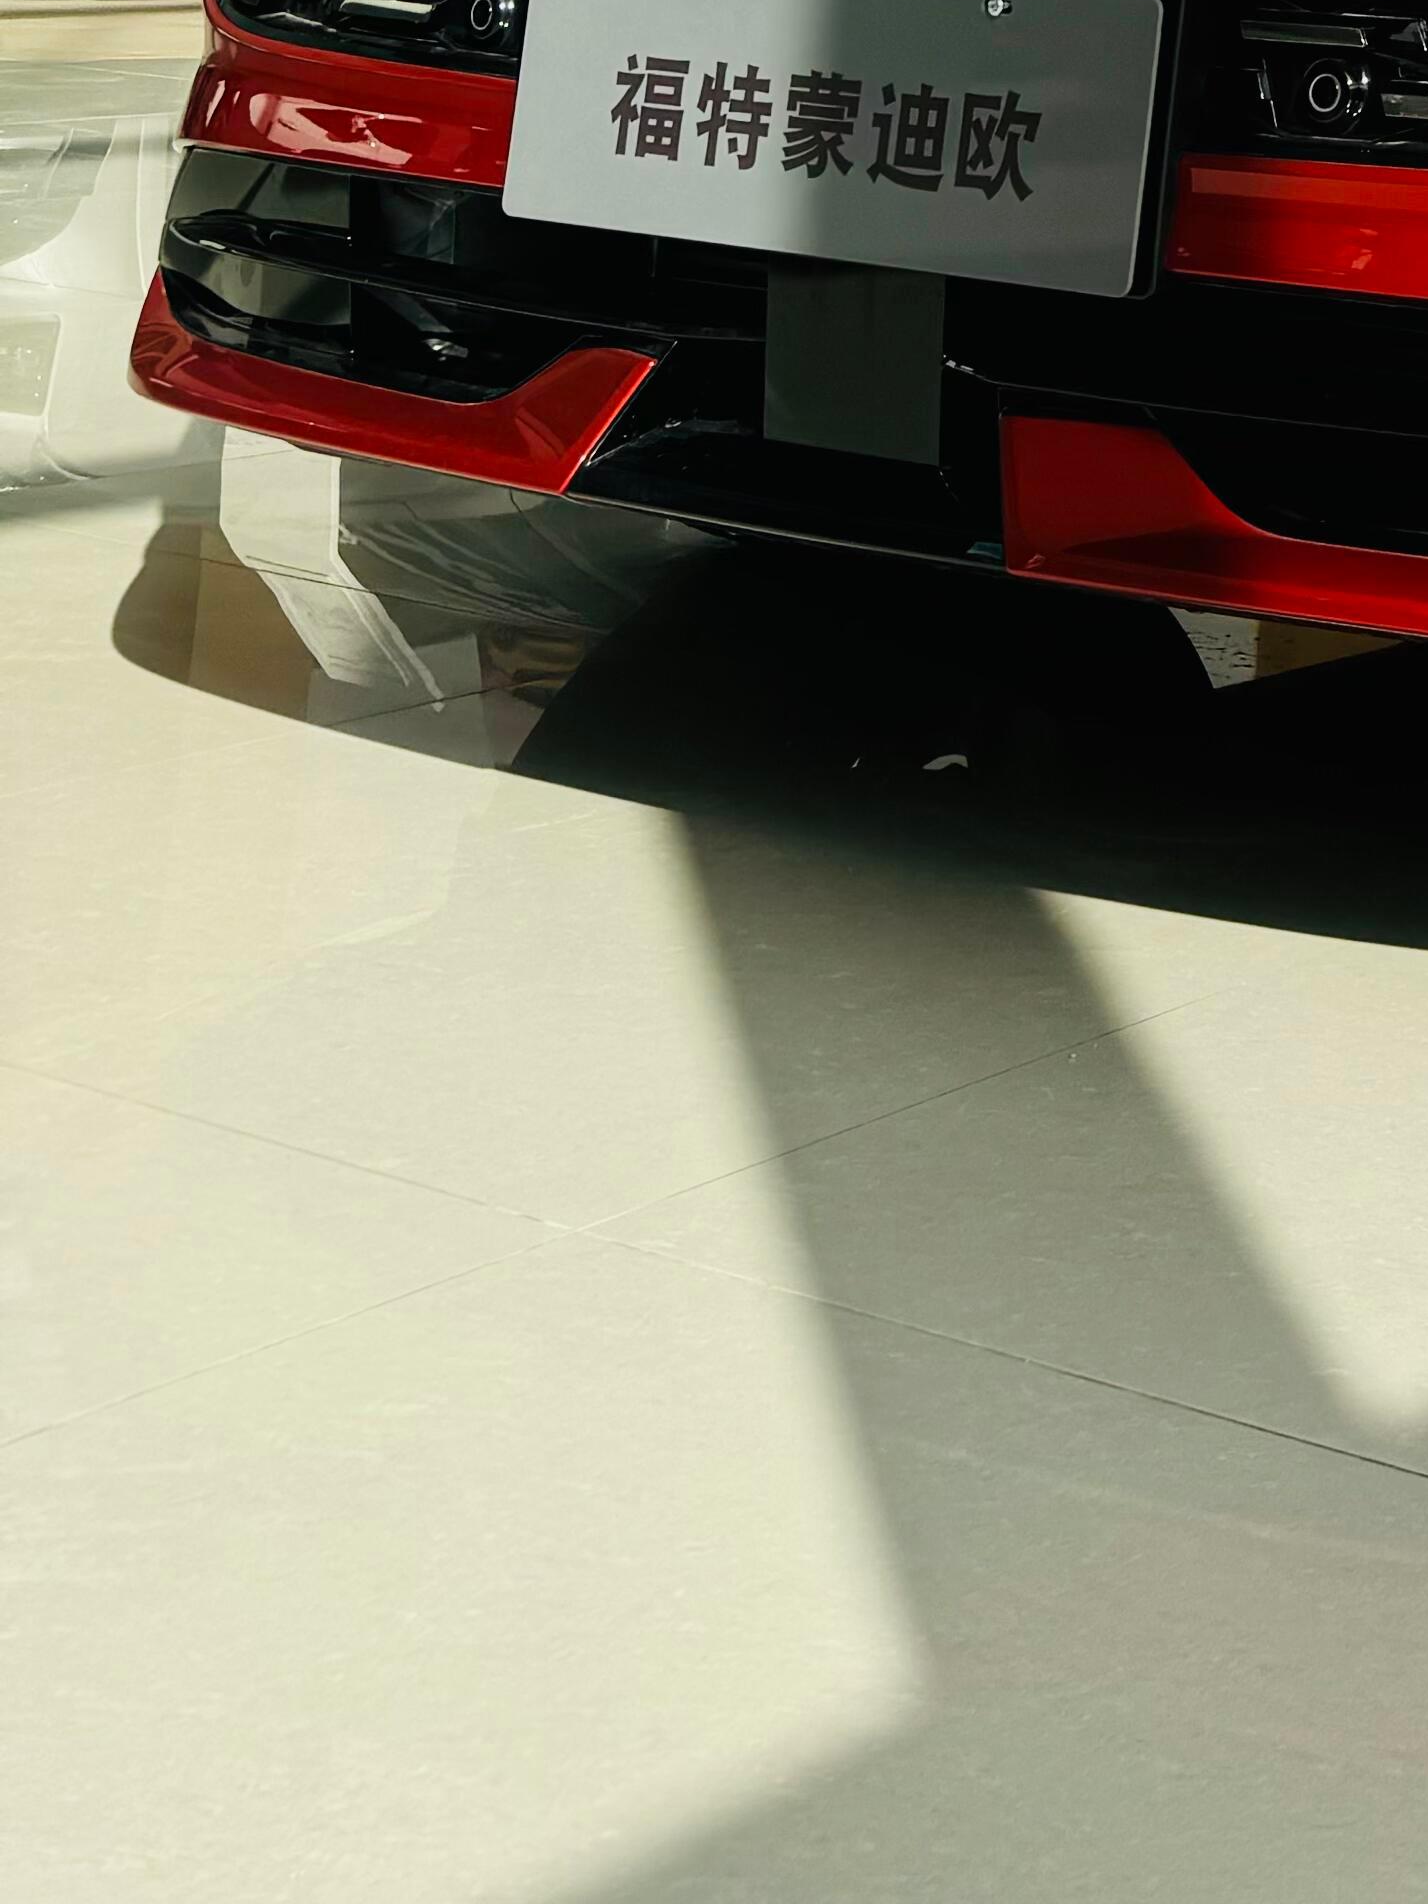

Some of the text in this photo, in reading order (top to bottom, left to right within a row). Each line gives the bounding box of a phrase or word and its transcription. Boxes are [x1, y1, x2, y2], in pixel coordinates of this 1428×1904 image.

[609, 53, 1043, 202] 福特蒙迪欧
